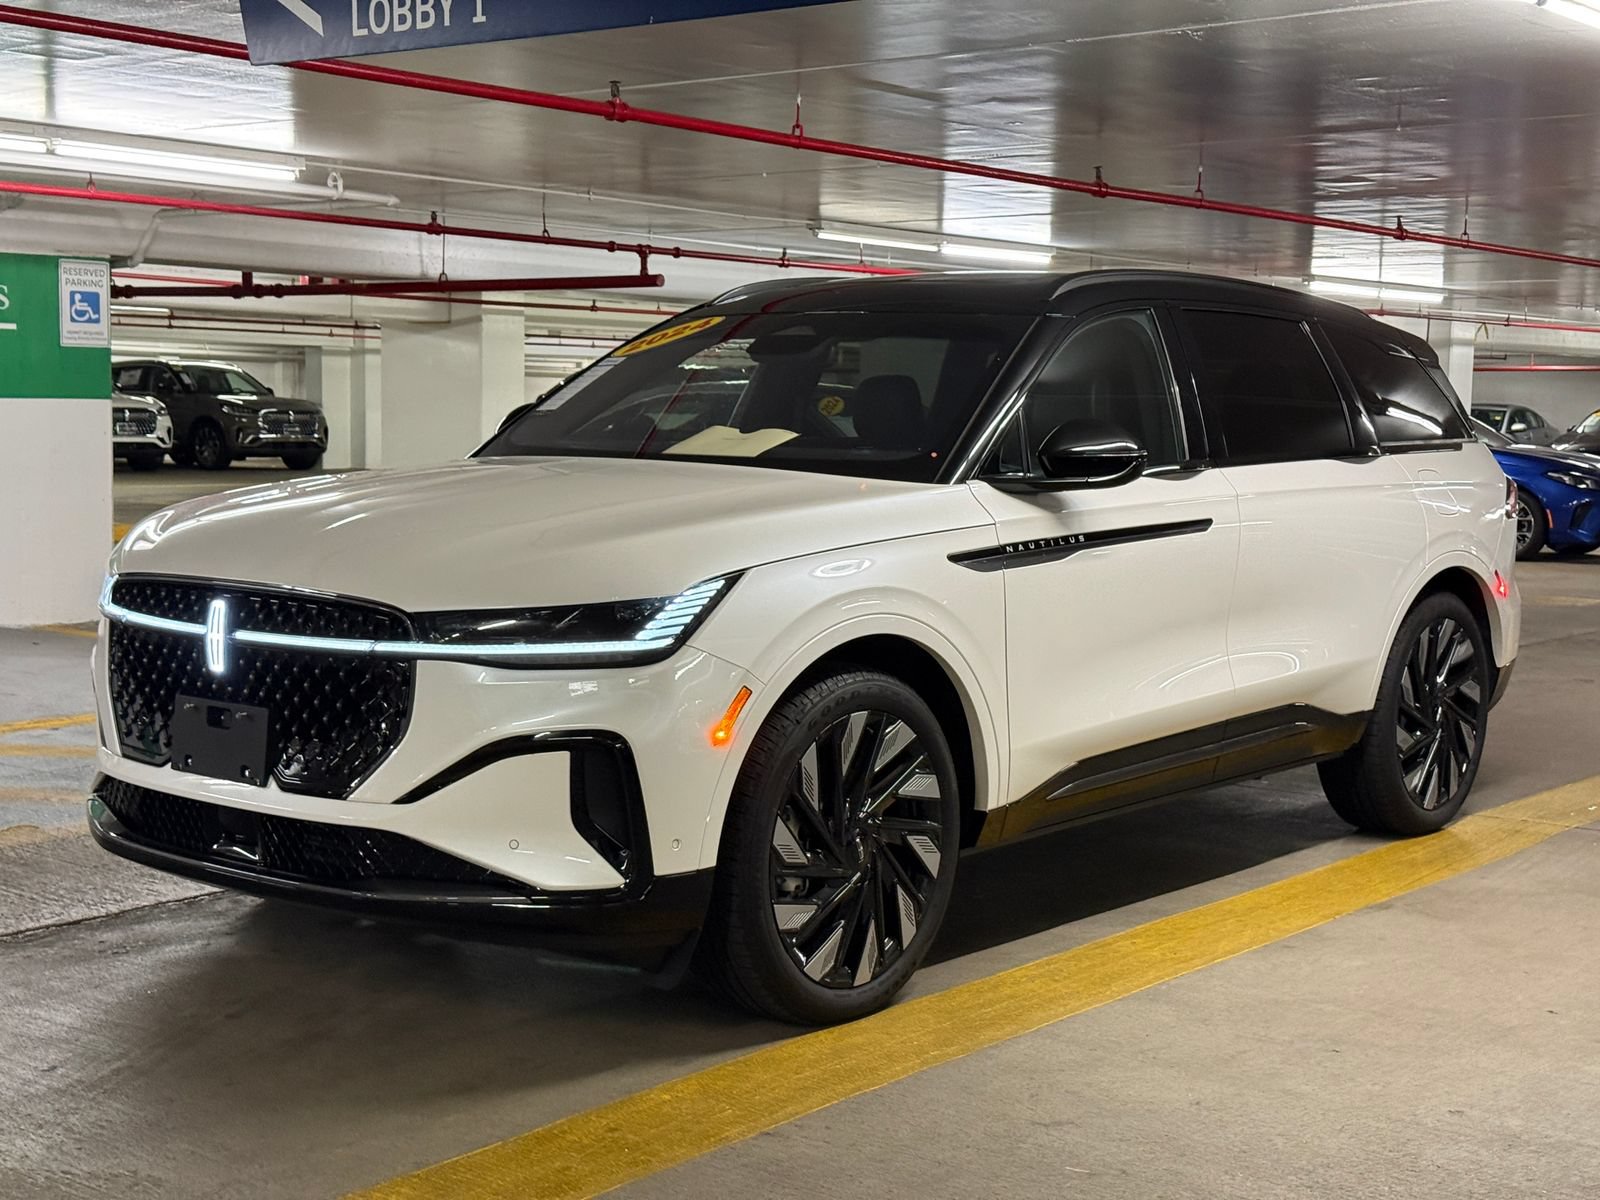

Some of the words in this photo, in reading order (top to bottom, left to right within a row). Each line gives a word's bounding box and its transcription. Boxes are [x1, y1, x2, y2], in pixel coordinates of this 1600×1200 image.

[352, 0, 452, 36] LOBBY
[63, 267, 106, 278] RESERVED
[65, 277, 104, 288] PARKING
[622, 317, 716, 354] 2024
[1006, 535, 1085, 553] NAUTILUS
